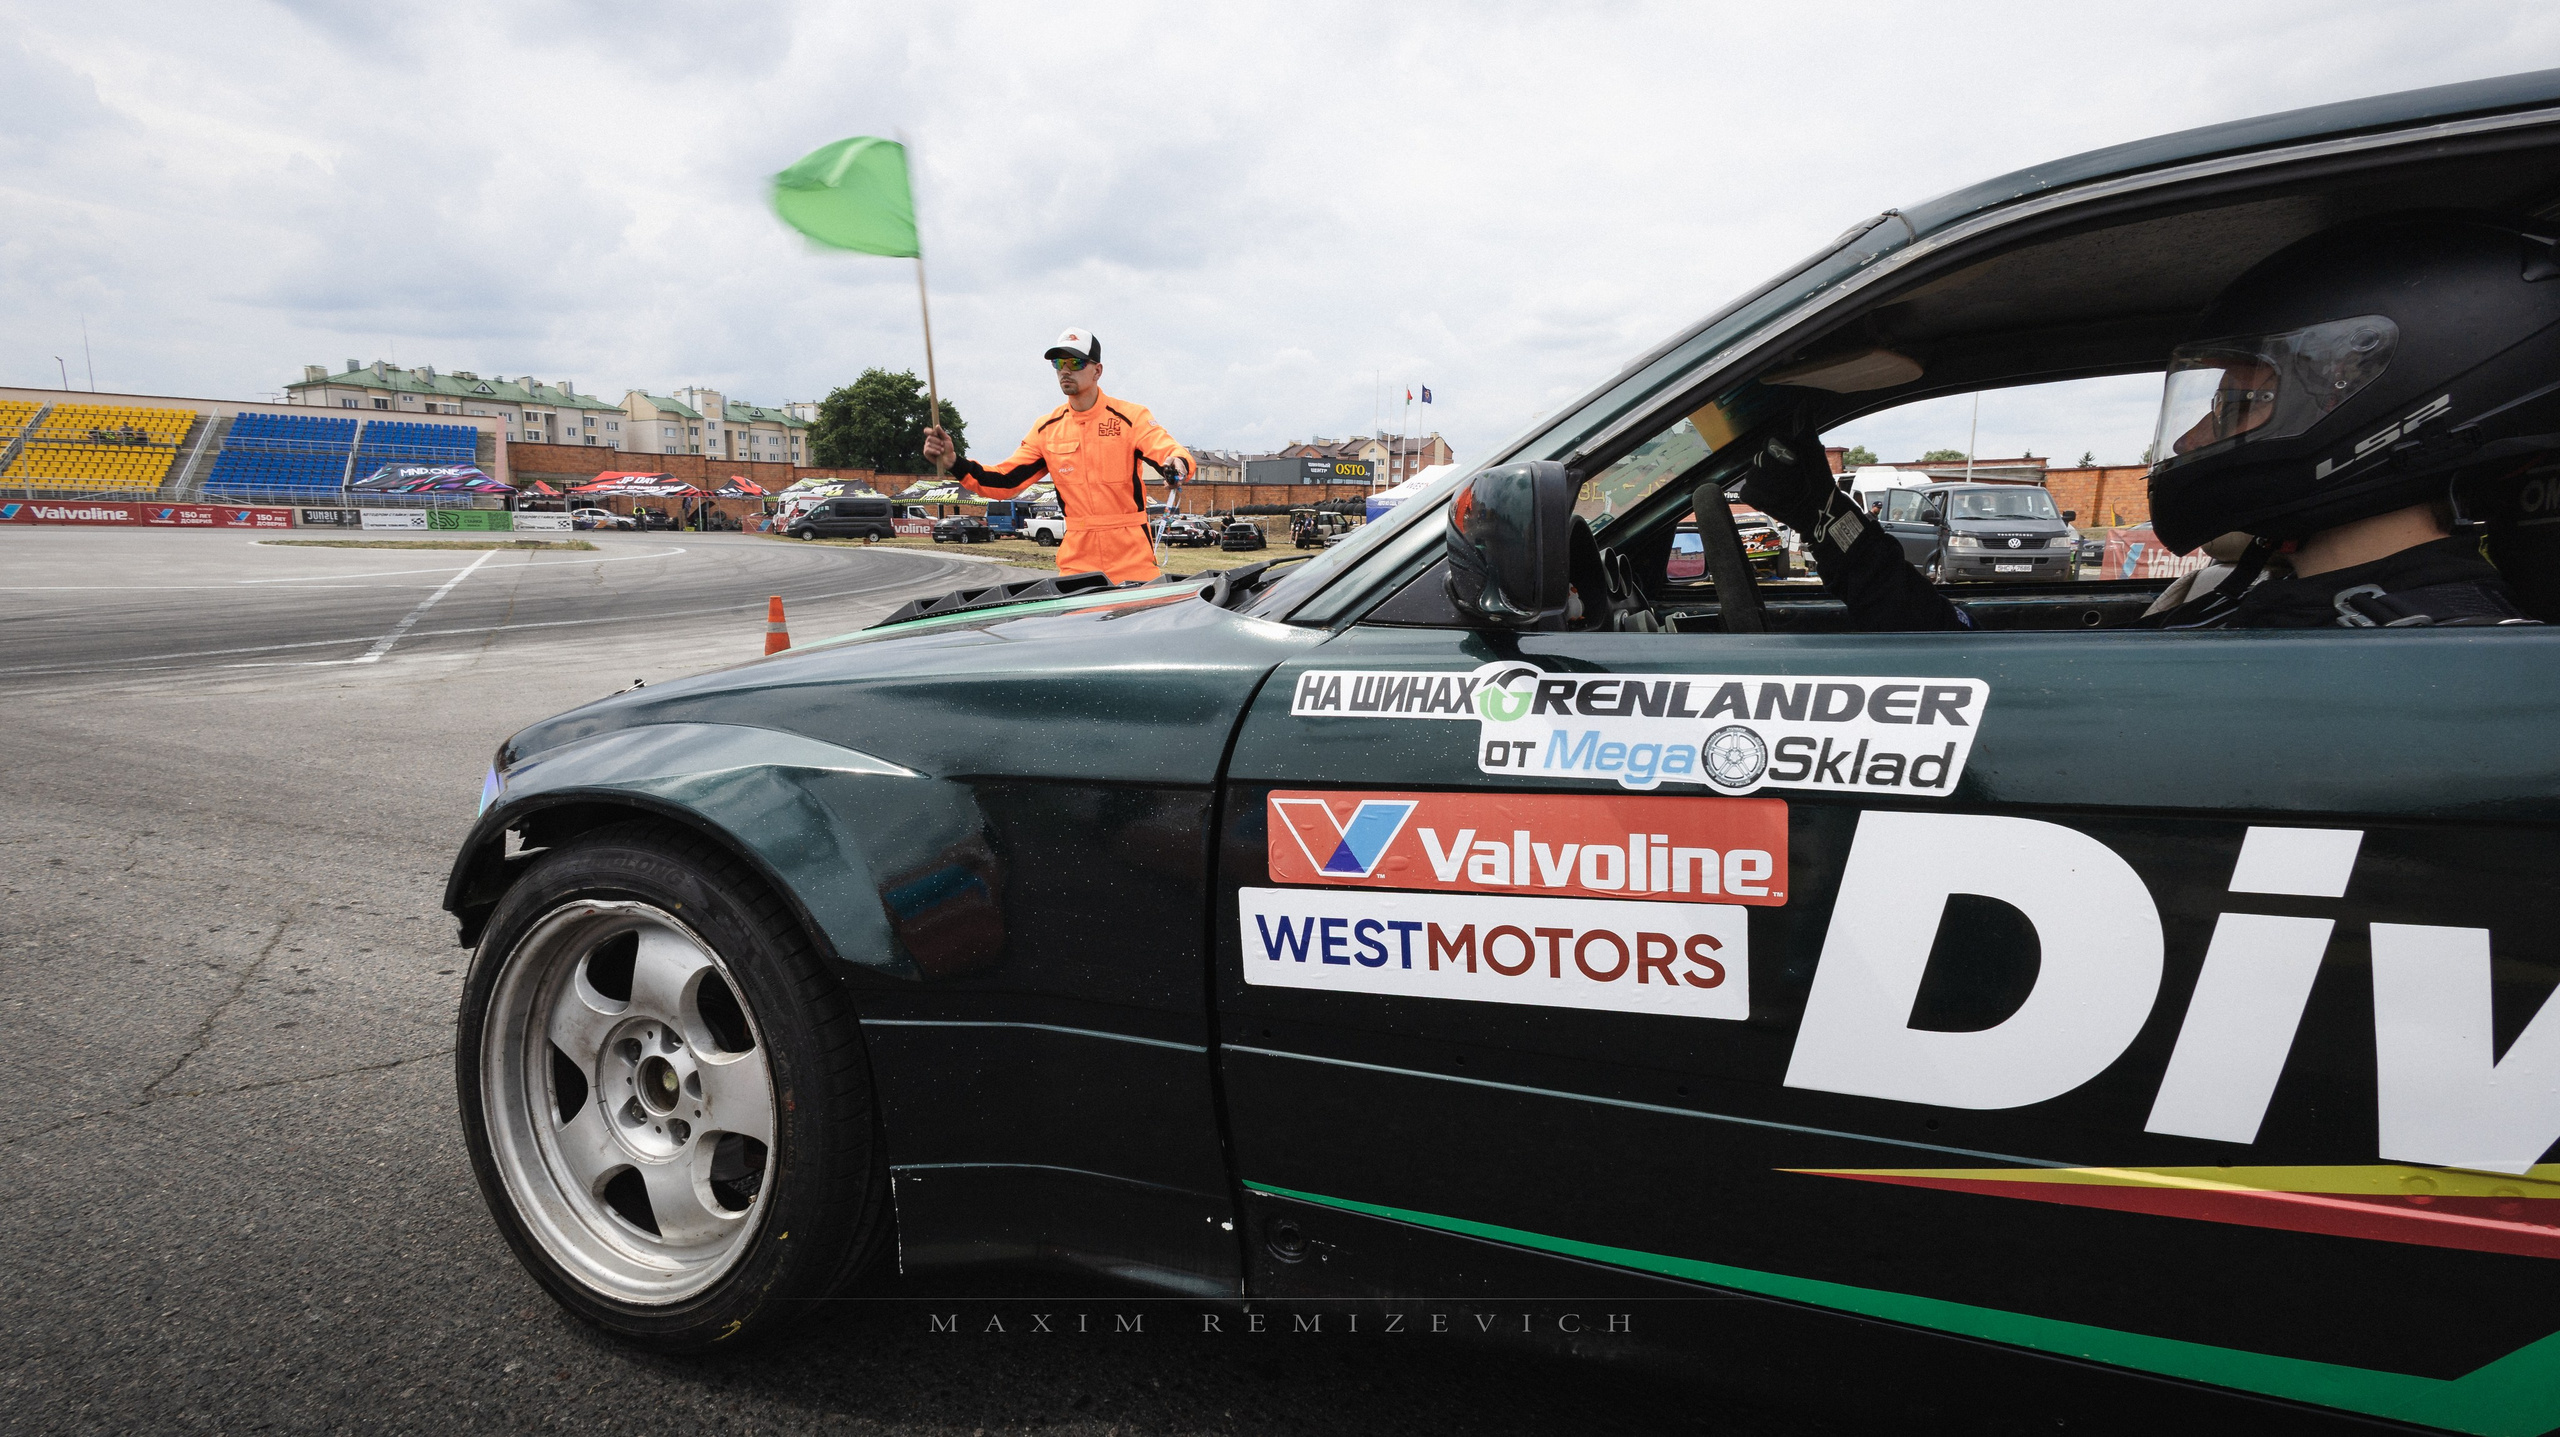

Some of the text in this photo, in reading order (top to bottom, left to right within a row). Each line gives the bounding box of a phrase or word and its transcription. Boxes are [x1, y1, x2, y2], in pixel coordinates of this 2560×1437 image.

[400, 467, 460, 477] MND.ONE
[616, 476, 634, 484] JP
[30, 506, 128, 520] Valvoline
[180, 511, 197, 519] 150
[895, 522, 931, 534] voline
[1298, 675, 1479, 714] НА ШИНАХ
[1477, 666, 1972, 727] GRENLANDER
[1416, 827, 1774, 898] Valvoline
[1255, 914, 1726, 989] WESTMOTORS
